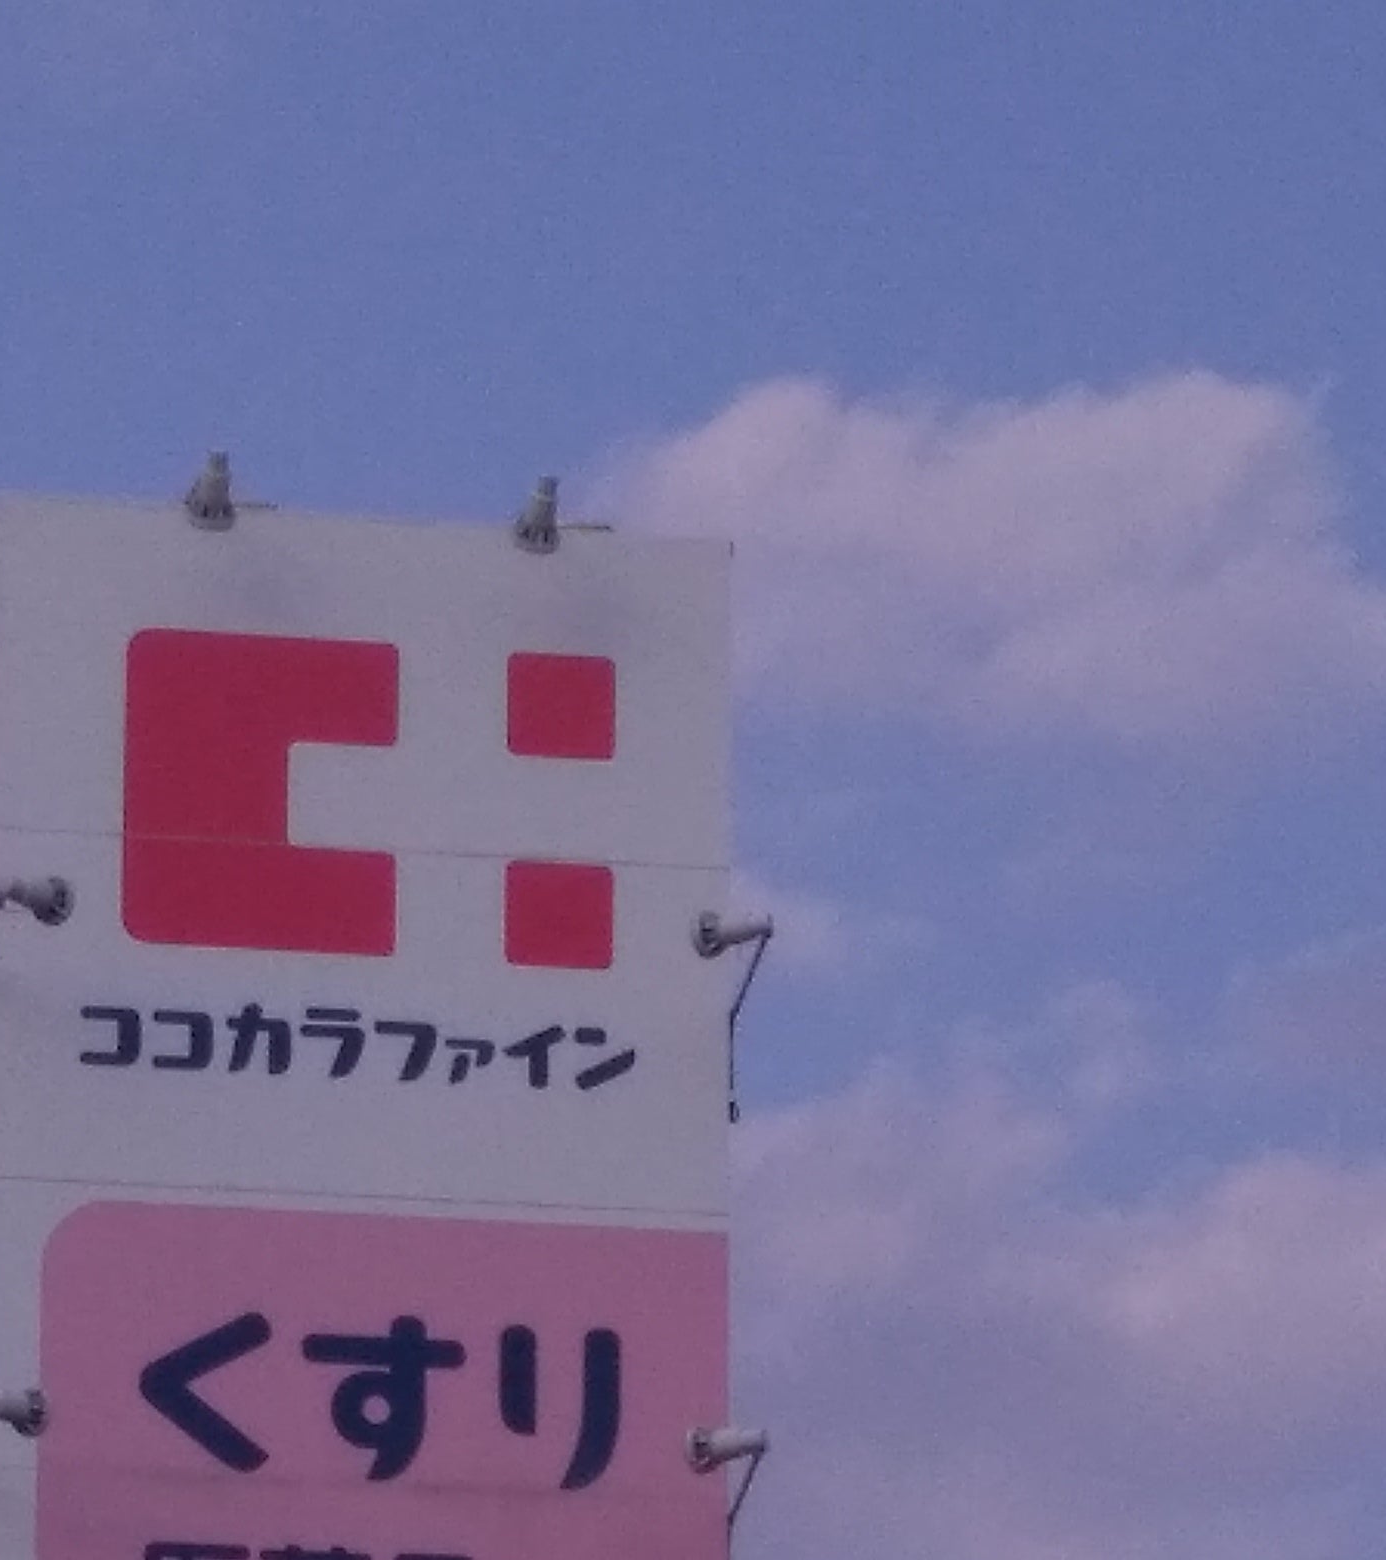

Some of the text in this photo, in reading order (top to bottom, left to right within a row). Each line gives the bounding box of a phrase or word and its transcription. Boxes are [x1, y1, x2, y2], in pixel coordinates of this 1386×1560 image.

[80, 1003, 636, 1090] ココカラファイン
[138, 1311, 622, 1490] くすり
